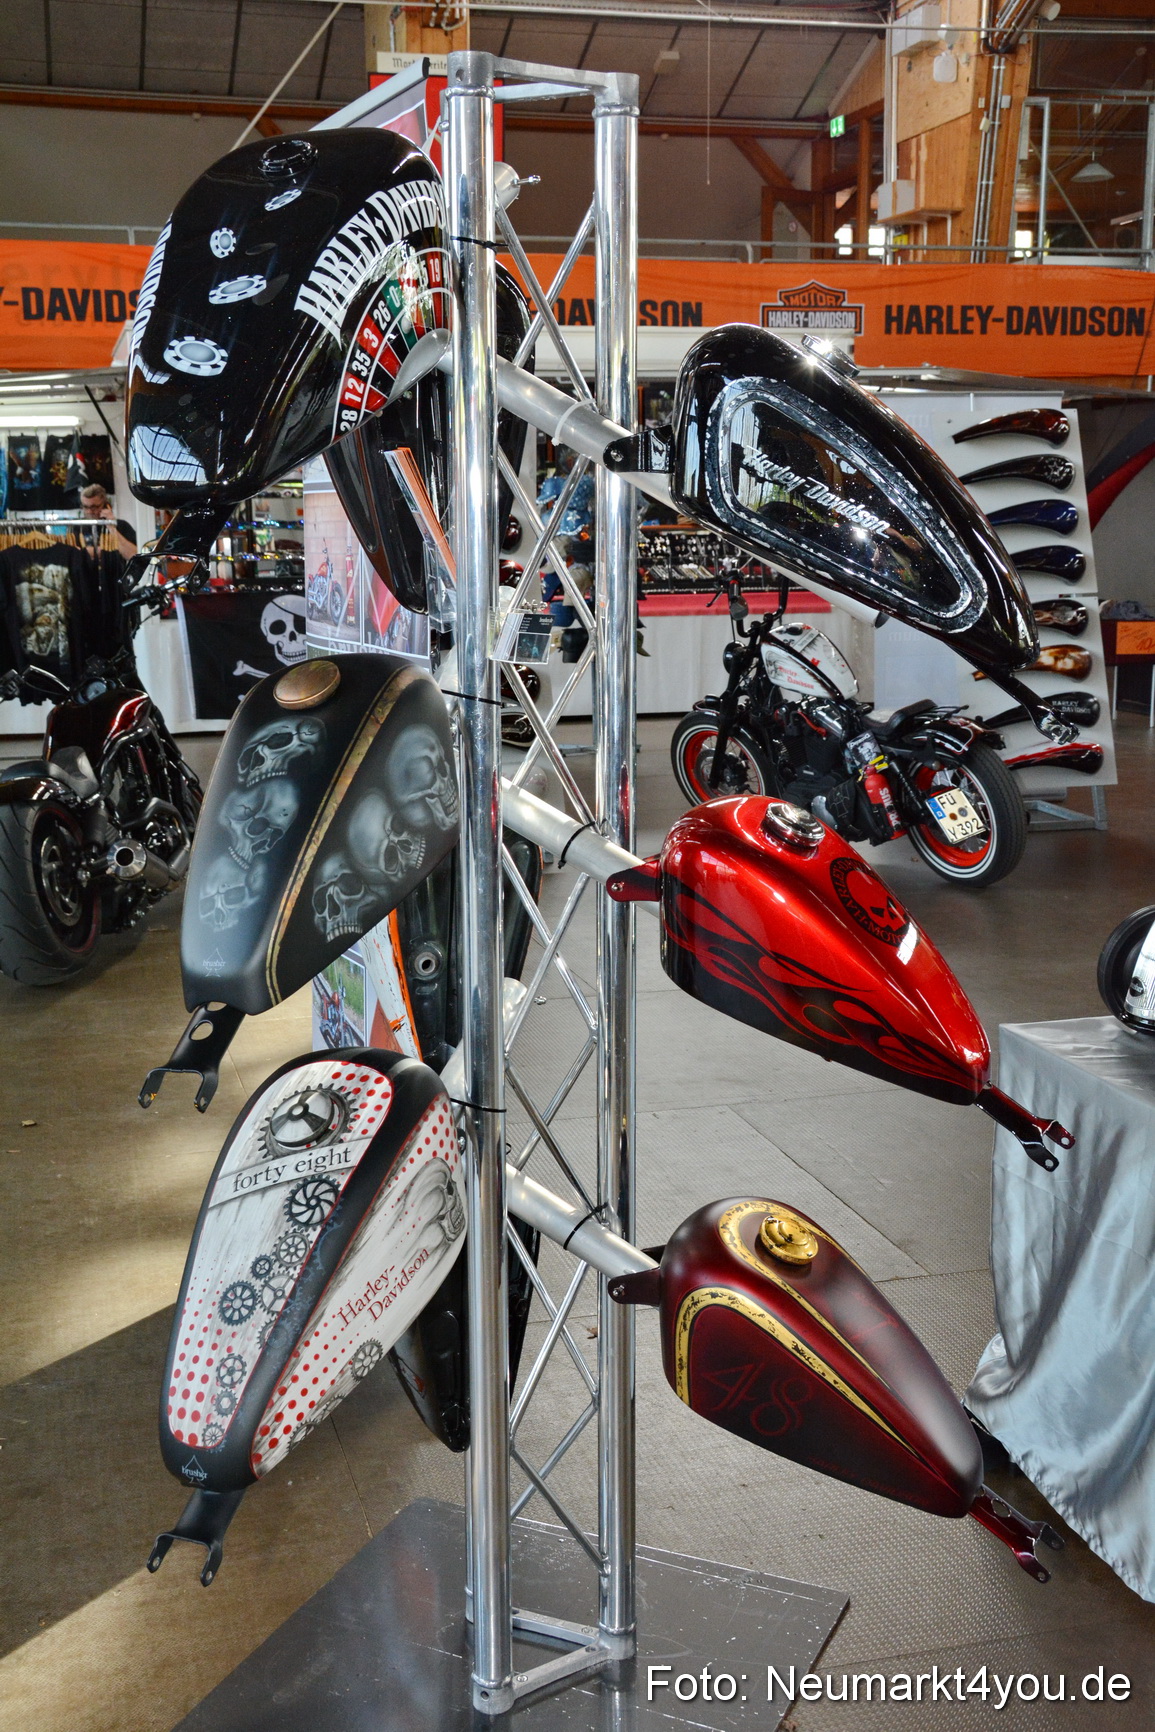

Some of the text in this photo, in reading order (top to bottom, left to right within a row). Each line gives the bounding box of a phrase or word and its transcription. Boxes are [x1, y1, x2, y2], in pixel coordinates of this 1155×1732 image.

[429, 258, 441, 283] 19
[788, 288, 837, 307] MOTOR
[373, 300, 392, 331] 26
[768, 310, 856, 328] HARLEY-DAVIDSON
[884, 304, 1146, 337] HARLEY-DAVIDSON
[363, 327, 379, 348] 3
[351, 349, 371, 377] 35
[344, 378, 364, 402] 12
[742, 444, 891, 539] Harley-Davidson
[937, 793, 957, 809] FÜ
[948, 817, 984, 841] Y 392
[232, 1147, 352, 1193] forty eight
[336, 1265, 396, 1328] Harley-
[367, 1248, 431, 1323] Davidson
[702, 1361, 814, 1437] 48
